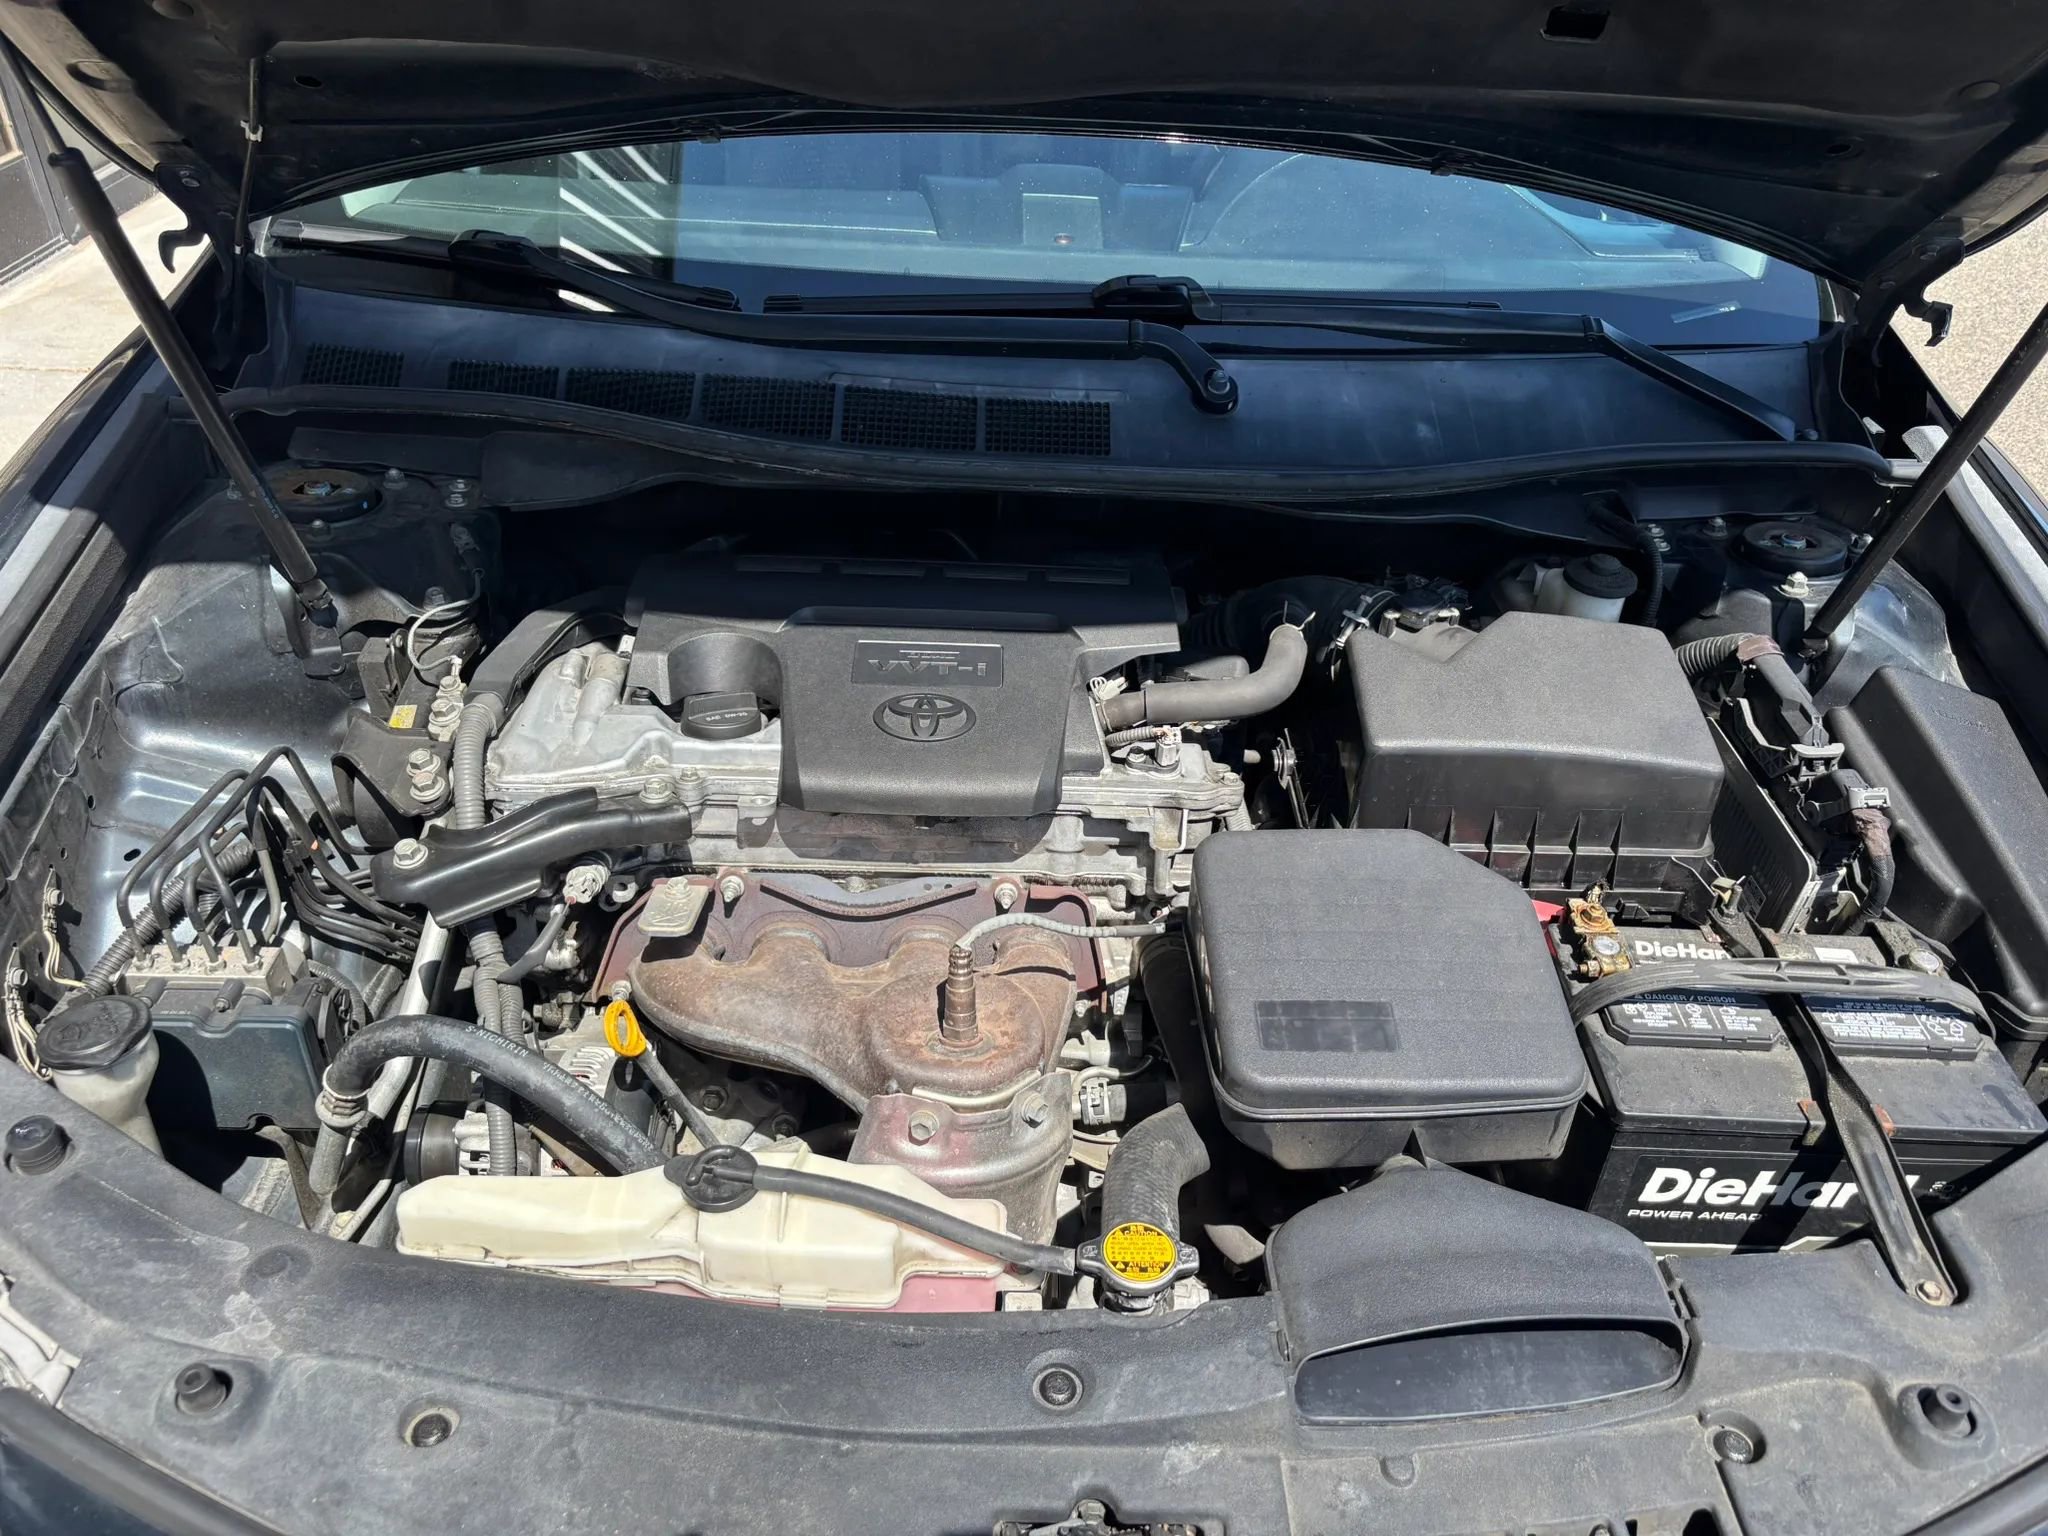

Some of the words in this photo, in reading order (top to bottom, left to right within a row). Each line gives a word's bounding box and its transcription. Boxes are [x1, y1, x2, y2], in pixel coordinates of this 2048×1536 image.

[1634, 940, 1731, 960] DieHar
[1644, 993, 1687, 1002] DANGER
[1697, 995, 1736, 1004] POISON
[1638, 1167, 1920, 1208] DieHar
[1628, 1209, 1694, 1220] POWER
[1698, 1210, 1761, 1221] AHEAD
